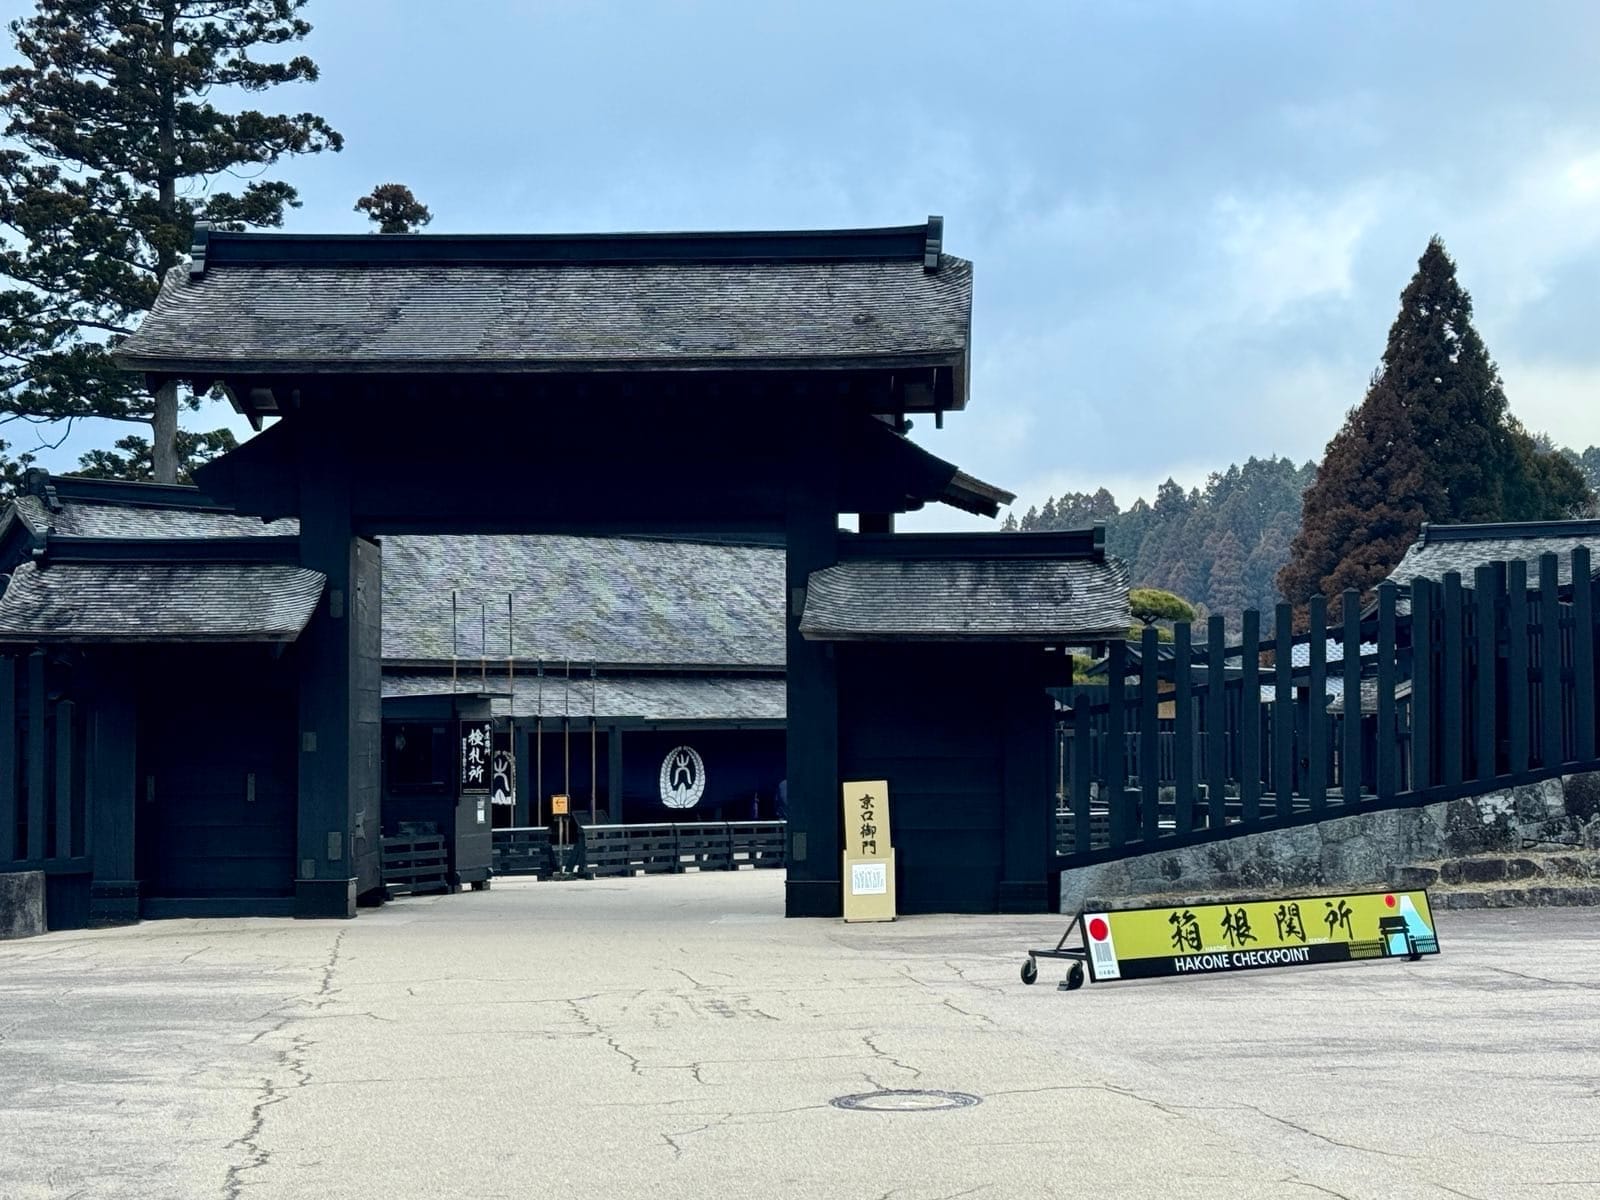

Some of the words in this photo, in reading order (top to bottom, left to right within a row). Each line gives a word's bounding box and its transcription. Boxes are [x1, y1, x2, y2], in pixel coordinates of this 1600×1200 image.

[859, 793, 877, 855] 京口御門
[1170, 899, 1355, 951] 箱根関所
[1174, 954, 1231, 972] HAKONE
[1232, 947, 1310, 967] CHECKPOINT
